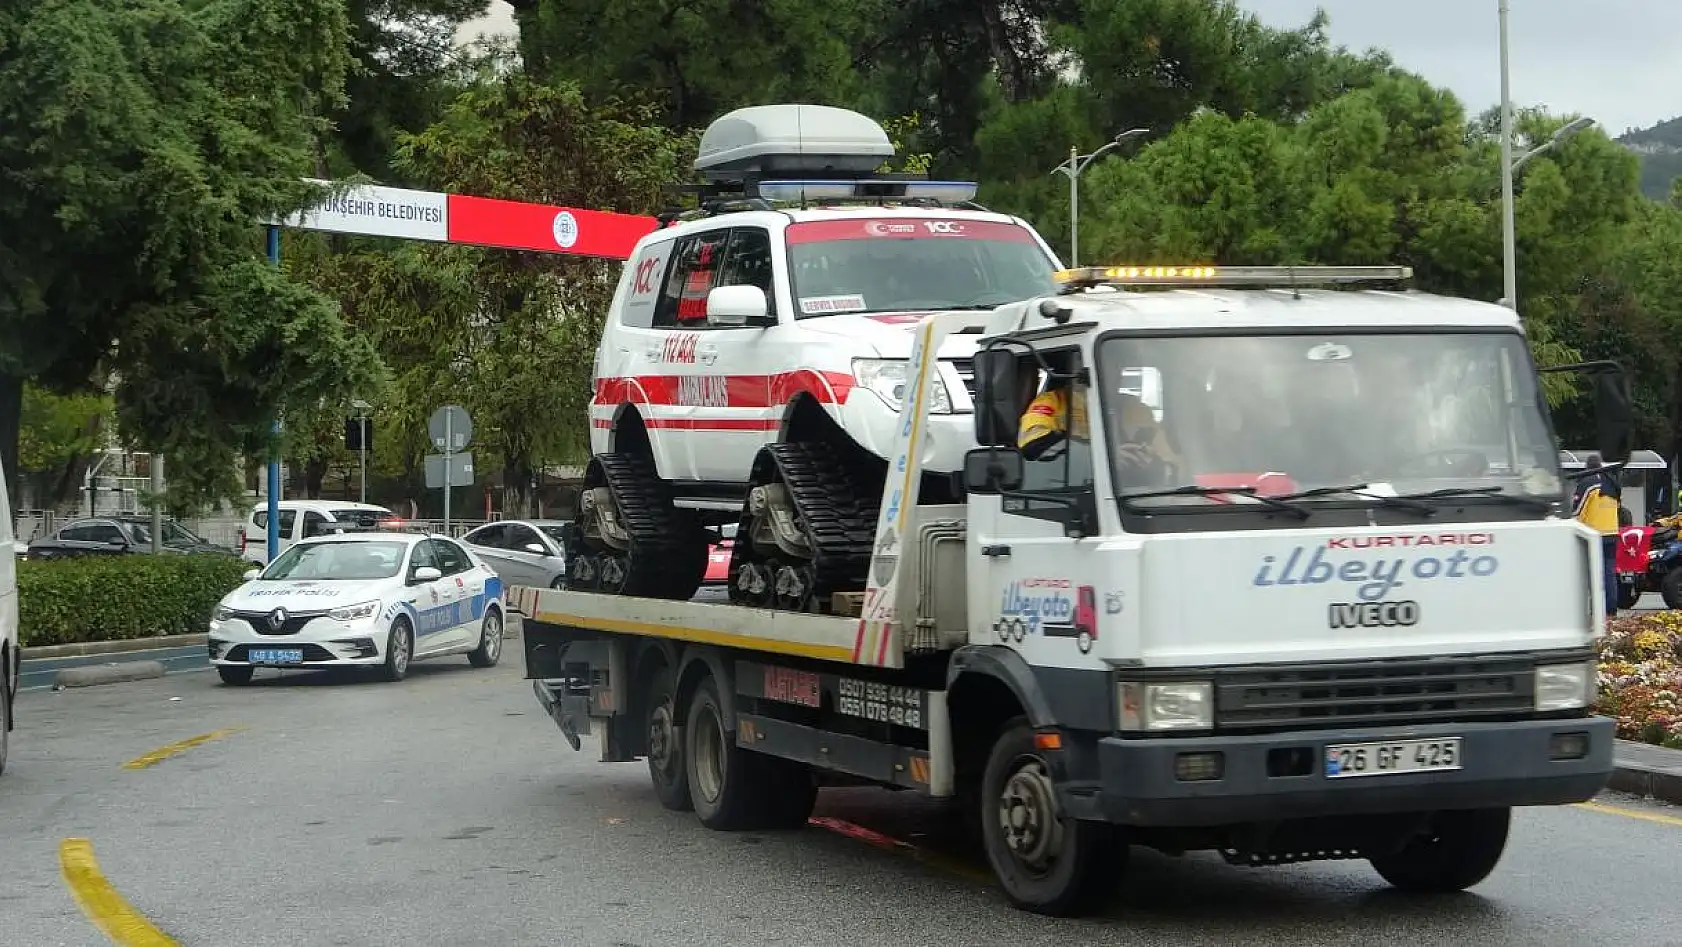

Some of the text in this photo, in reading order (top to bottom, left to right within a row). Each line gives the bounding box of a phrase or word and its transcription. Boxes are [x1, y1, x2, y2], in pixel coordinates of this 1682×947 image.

[378, 202, 443, 222] BELEDİYESİ
[1327, 533, 1495, 549] KURTARICI
[1253, 545, 1499, 601] ilbey oto
[1328, 600, 1420, 629] IVECO
[1341, 743, 1456, 771] 26 GF 425
